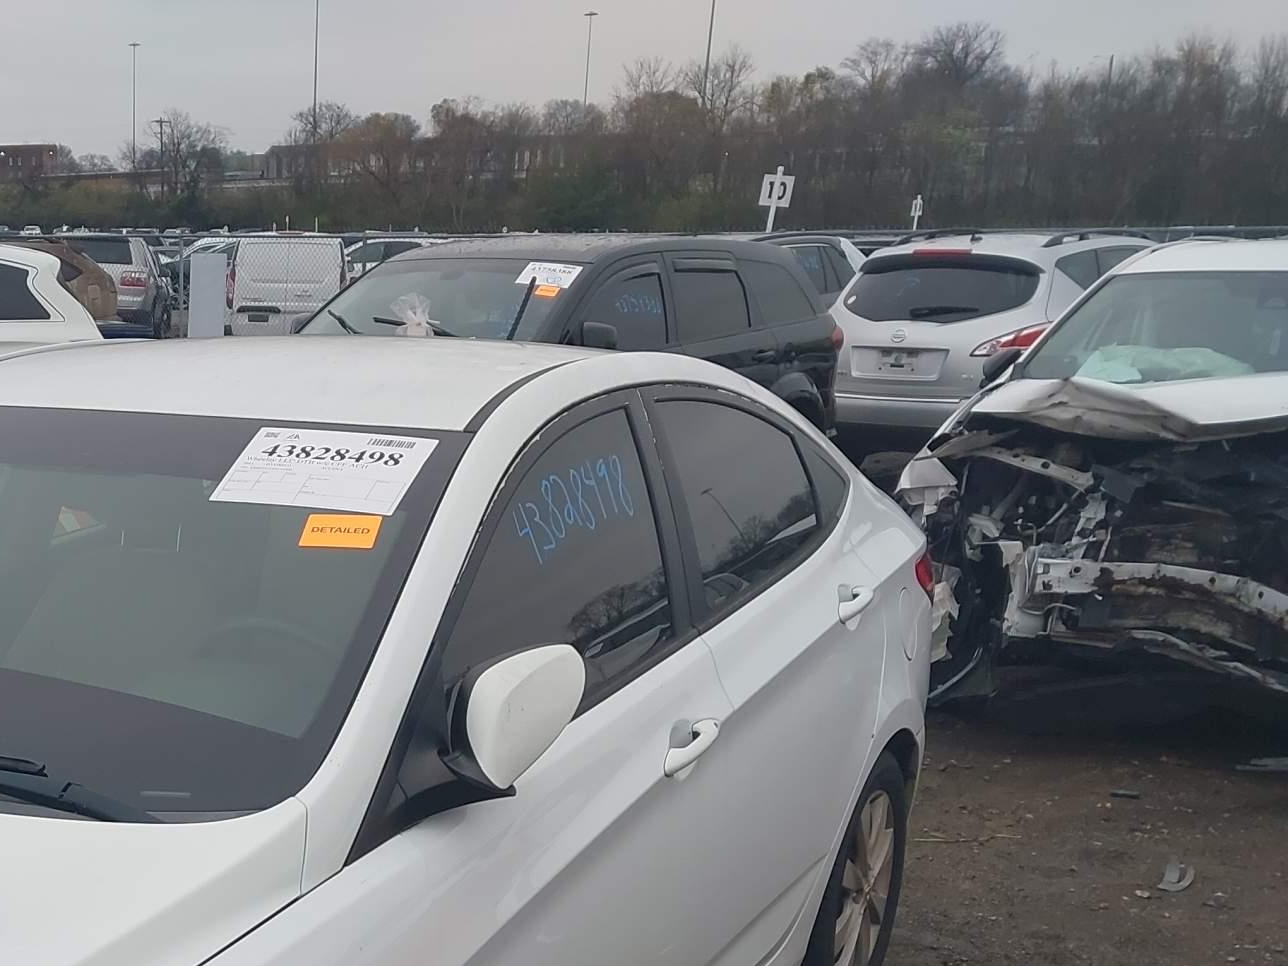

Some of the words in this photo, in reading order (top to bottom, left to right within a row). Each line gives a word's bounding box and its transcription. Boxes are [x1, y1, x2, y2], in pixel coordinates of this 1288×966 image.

[261, 443, 404, 467] 43828498
[513, 456, 634, 564] 43828498
[311, 525, 370, 536] DETAILED
